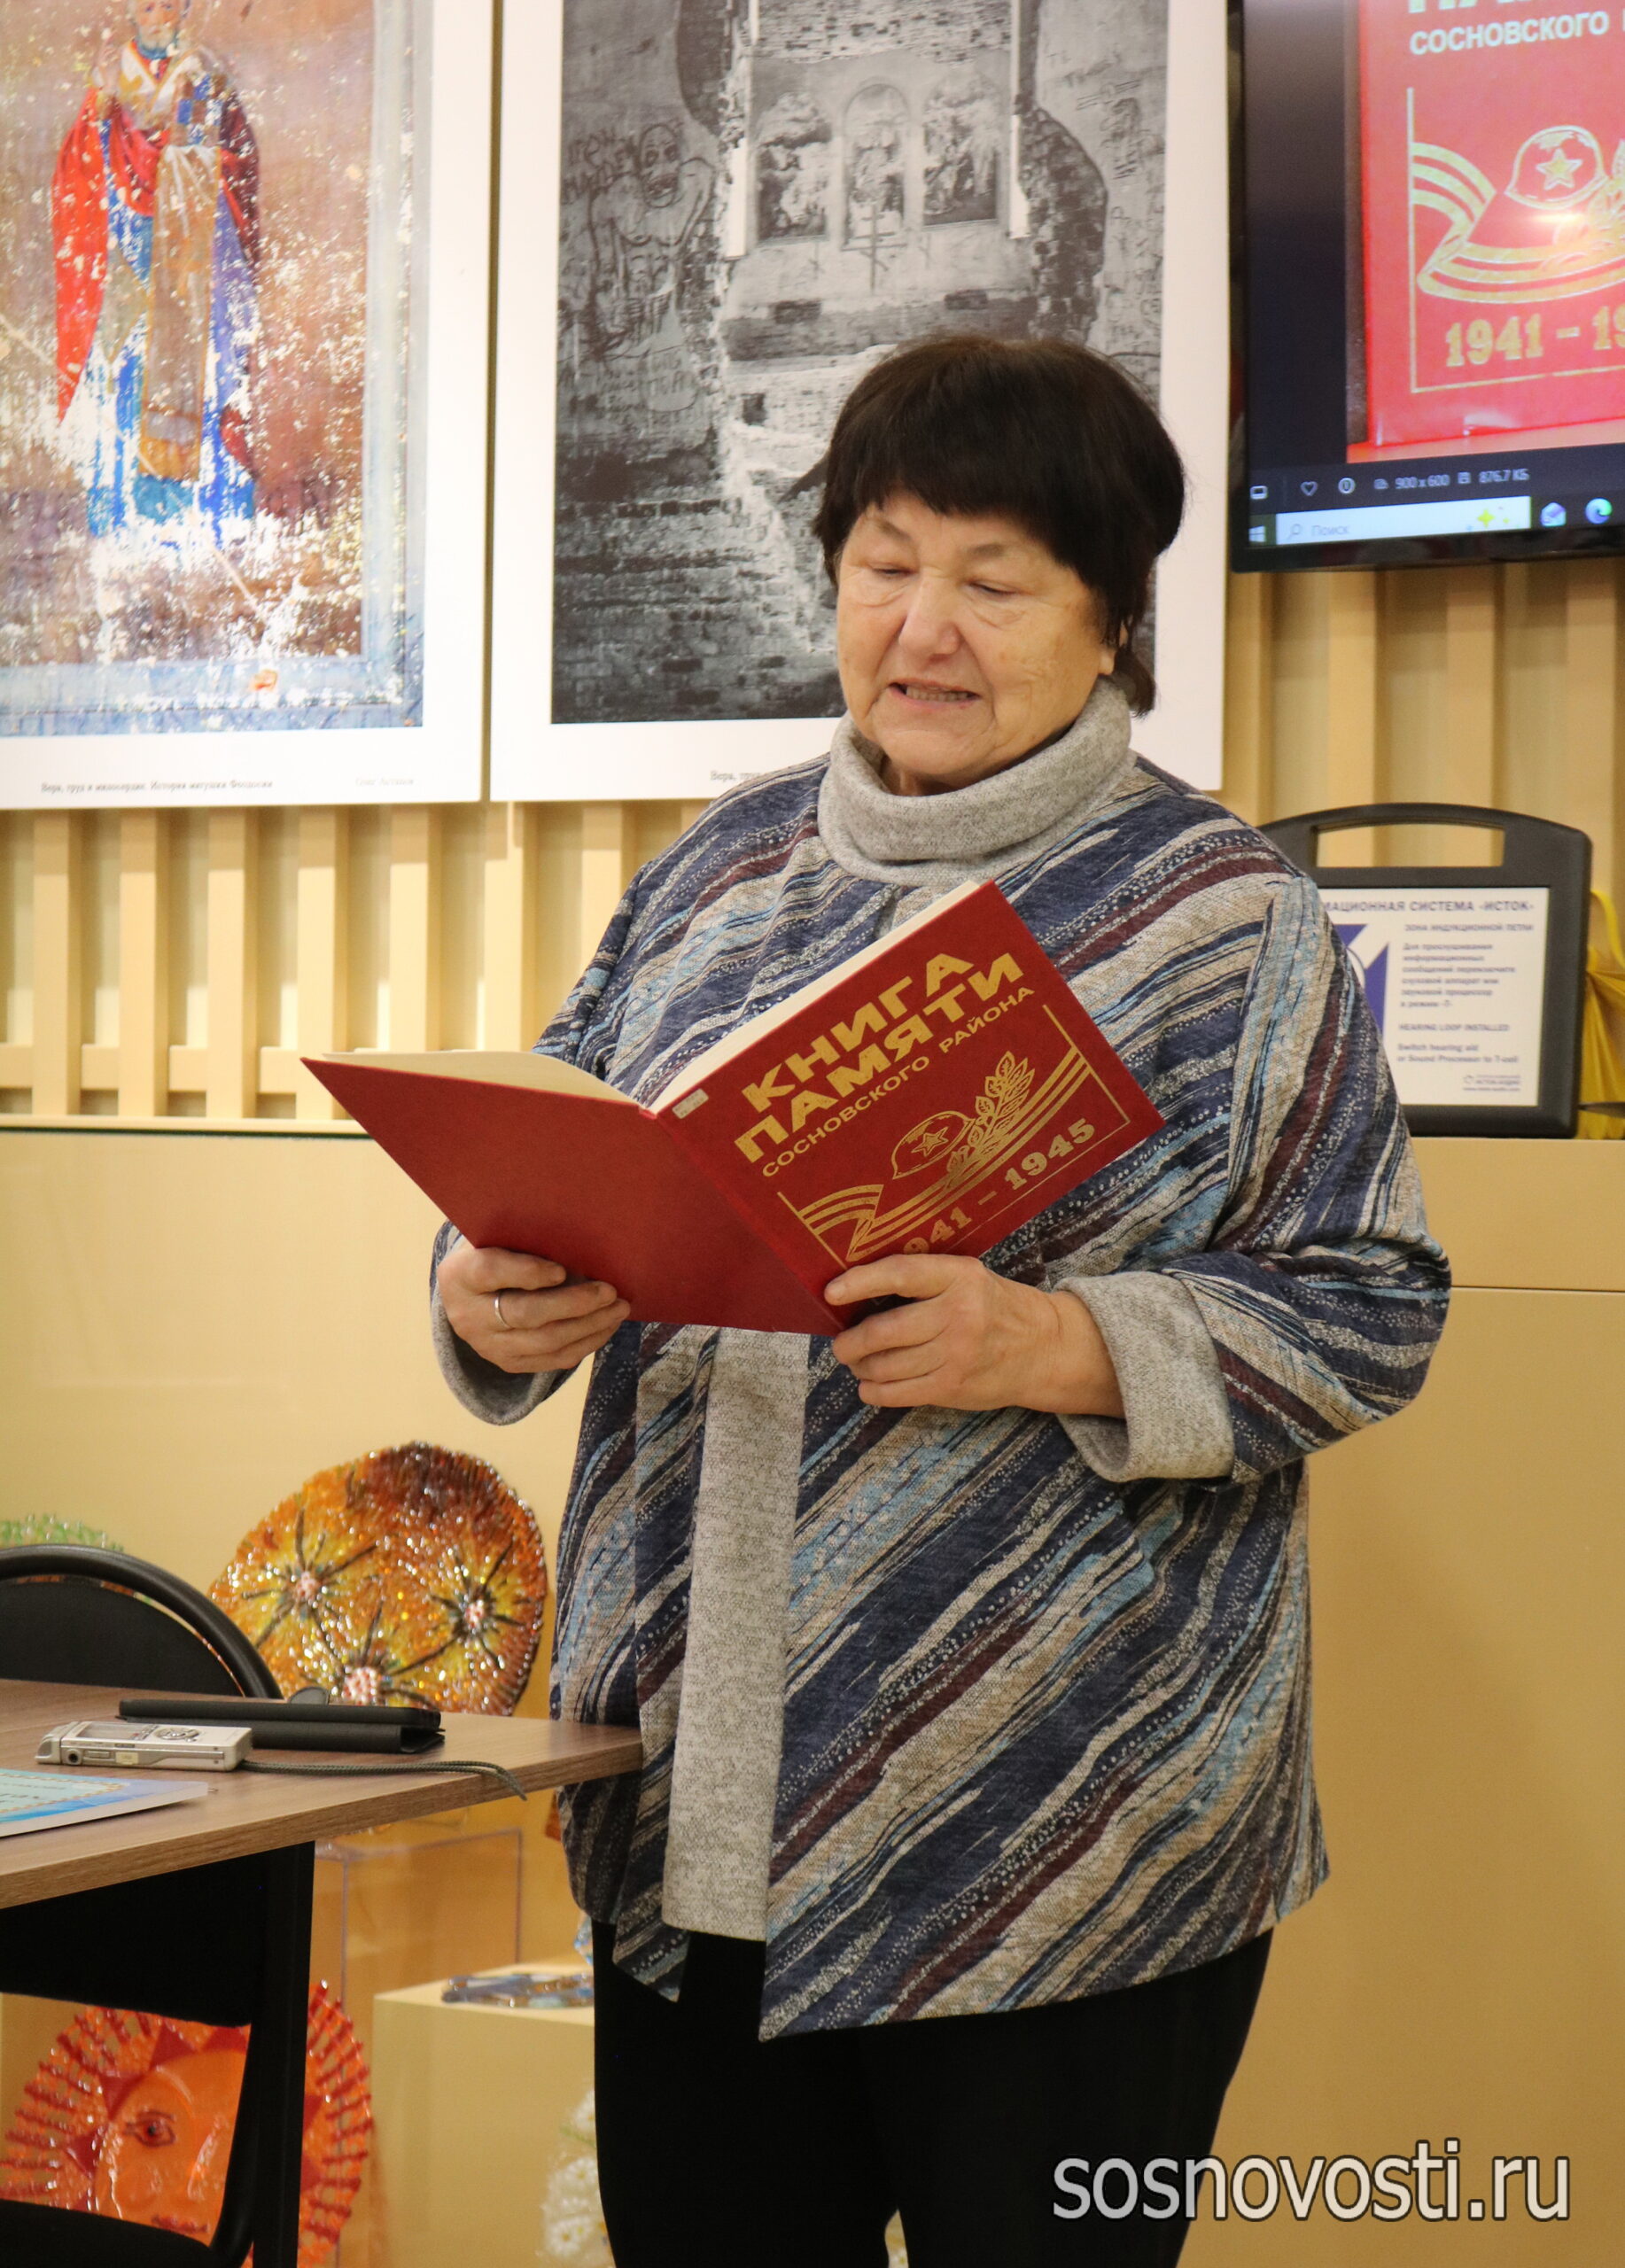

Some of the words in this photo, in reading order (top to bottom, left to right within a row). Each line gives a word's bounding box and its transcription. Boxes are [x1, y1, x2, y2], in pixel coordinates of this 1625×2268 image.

[1410, 11, 1609, 55] СОСНОВСКОГО
[1445, 314, 1543, 368] 1941
[1410, 900, 1474, 912] СИСТЕМА
[734, 952, 1024, 1163] ПАМЯТИ
[742, 953, 975, 1113] КНИГА
[762, 1056, 929, 1177] СОСНОВСКОГО
[938, 987, 1035, 1053] РАЙОНА
[903, 1207, 972, 1254] 941
[1004, 1118, 1096, 1192] 1945
